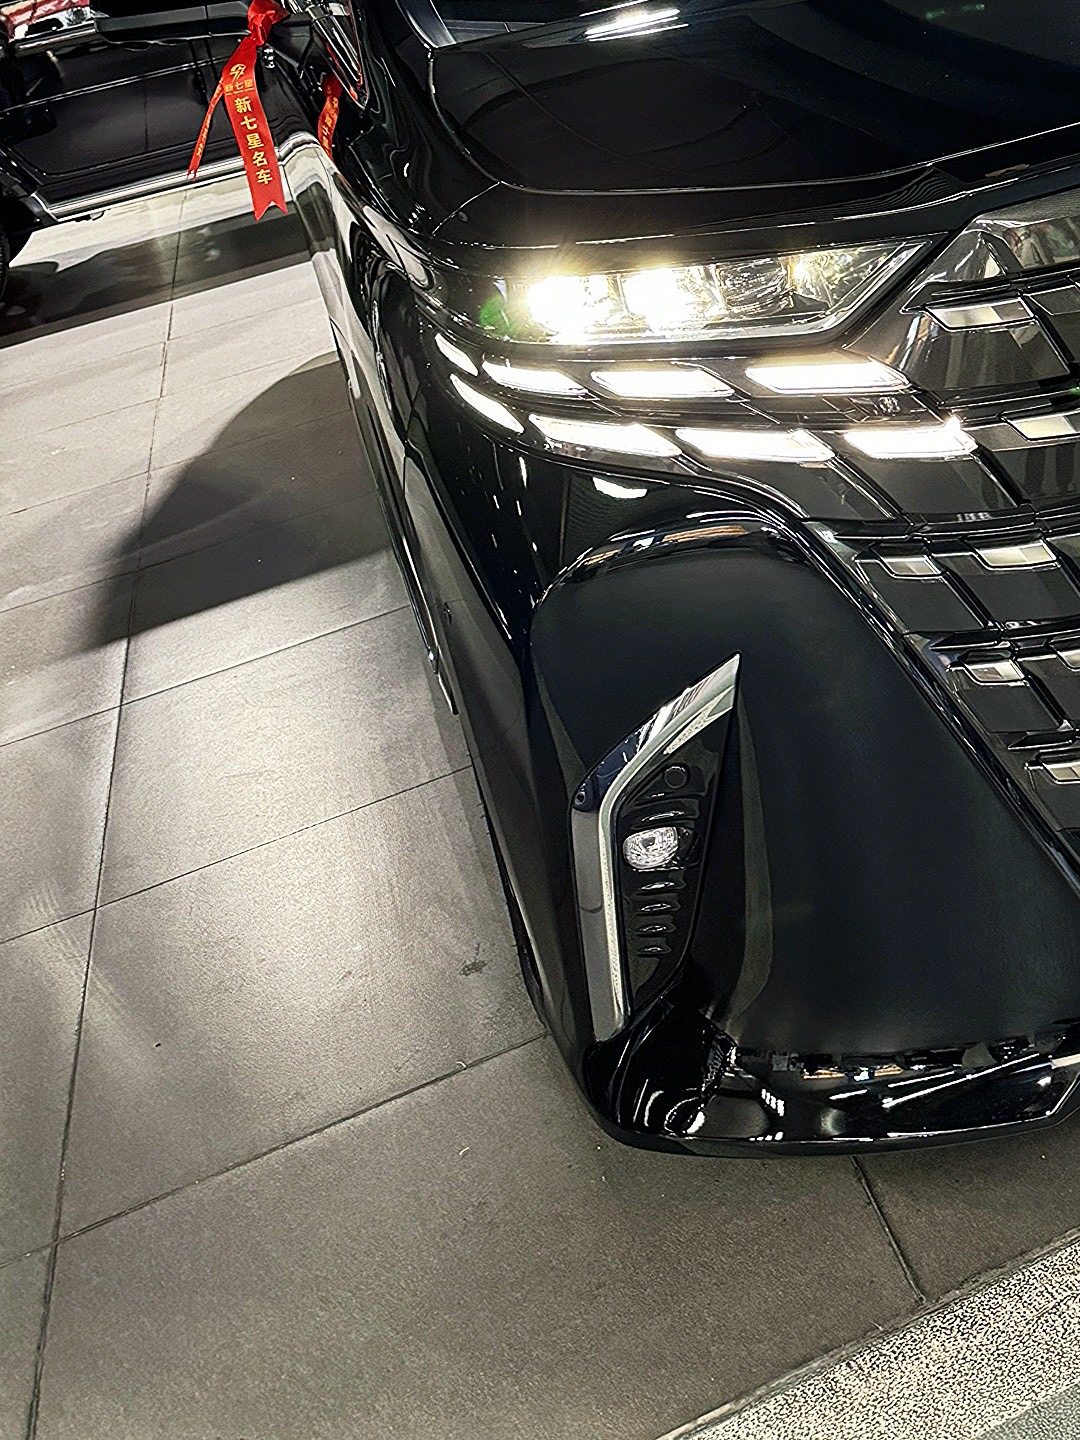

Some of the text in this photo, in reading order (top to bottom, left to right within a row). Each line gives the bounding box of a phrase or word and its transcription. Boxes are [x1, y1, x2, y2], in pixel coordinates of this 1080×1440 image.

[234, 95, 273, 185] 新七星名车
